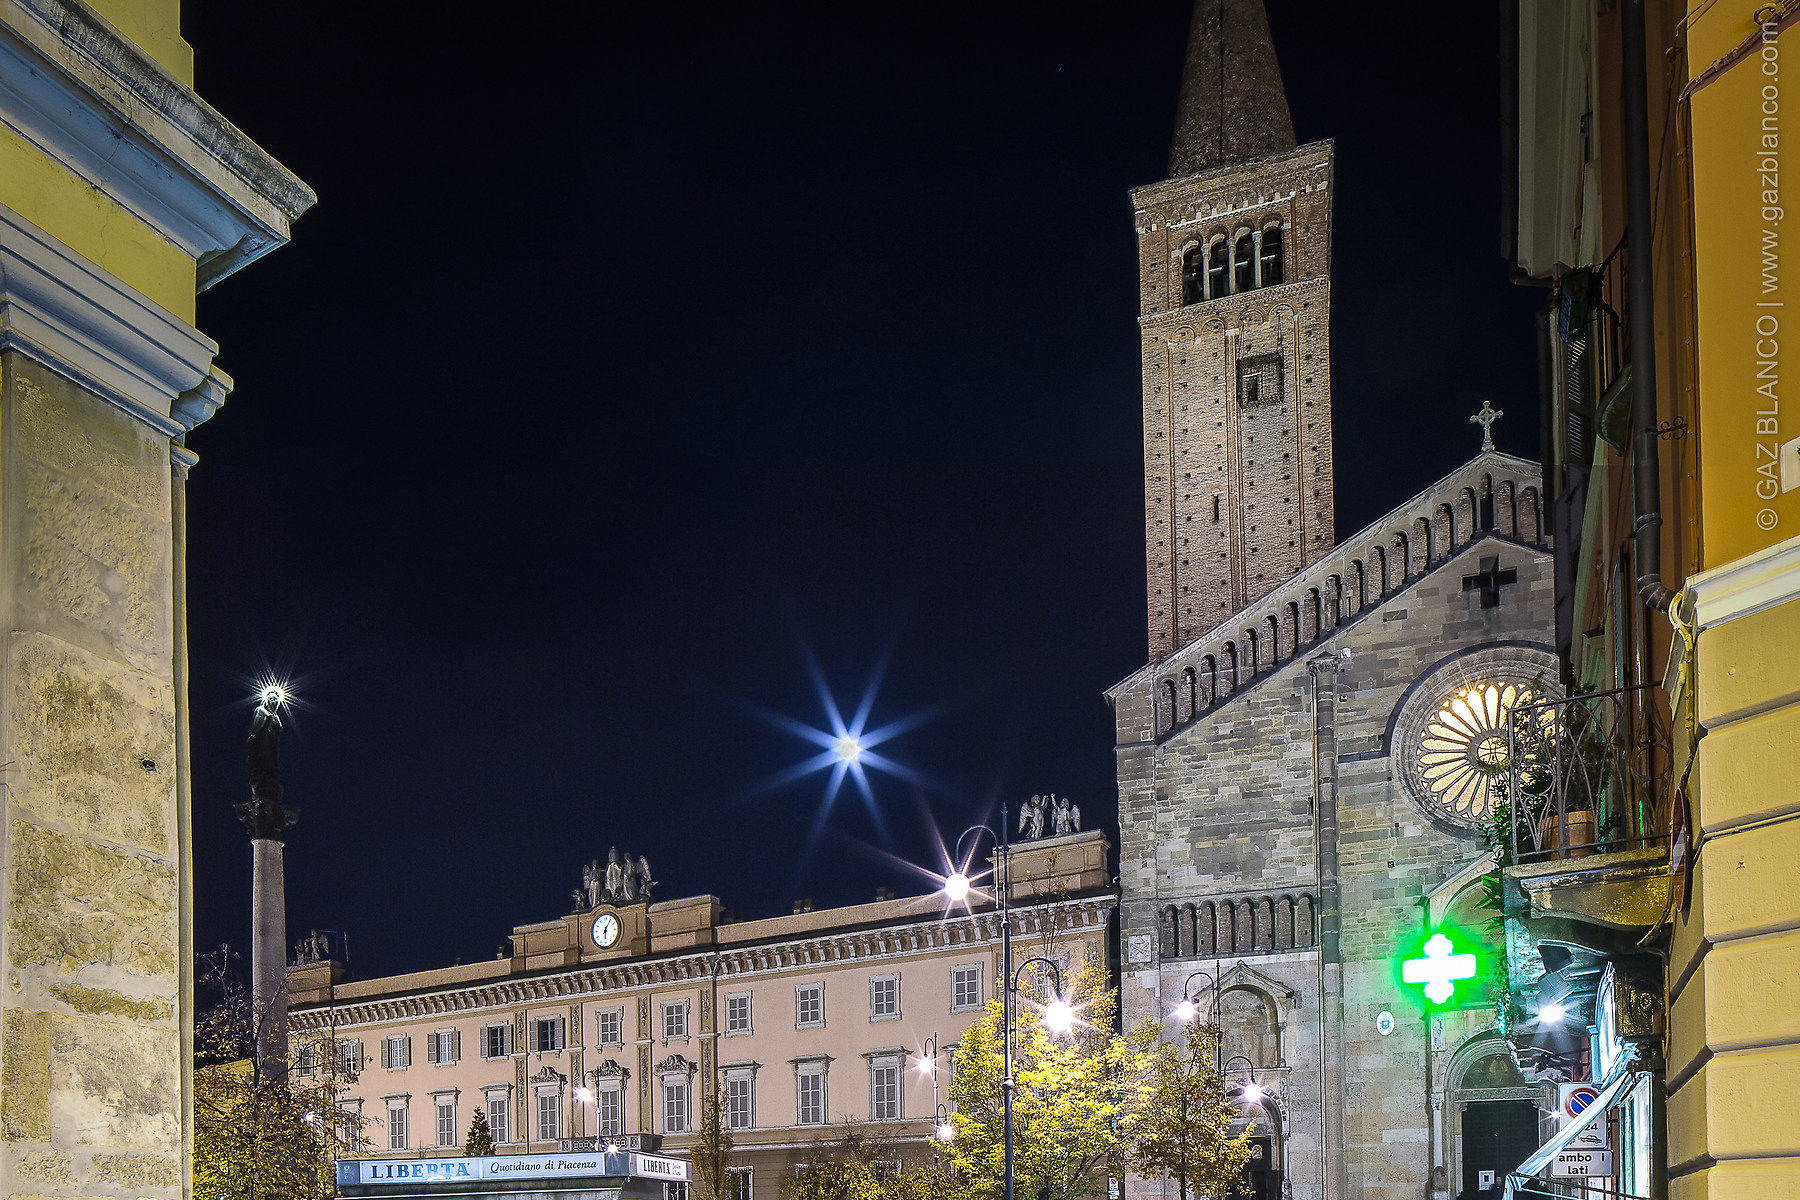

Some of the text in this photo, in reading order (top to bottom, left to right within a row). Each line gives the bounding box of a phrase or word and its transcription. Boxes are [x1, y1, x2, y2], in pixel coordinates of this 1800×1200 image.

[1558, 1152, 1605, 1162] ambo i
[490, 1161, 541, 1174] Quotidiano
[544, 1159, 554, 1170] di
[557, 1160, 597, 1170] Piacenza
[1567, 1165, 1589, 1175] lati
